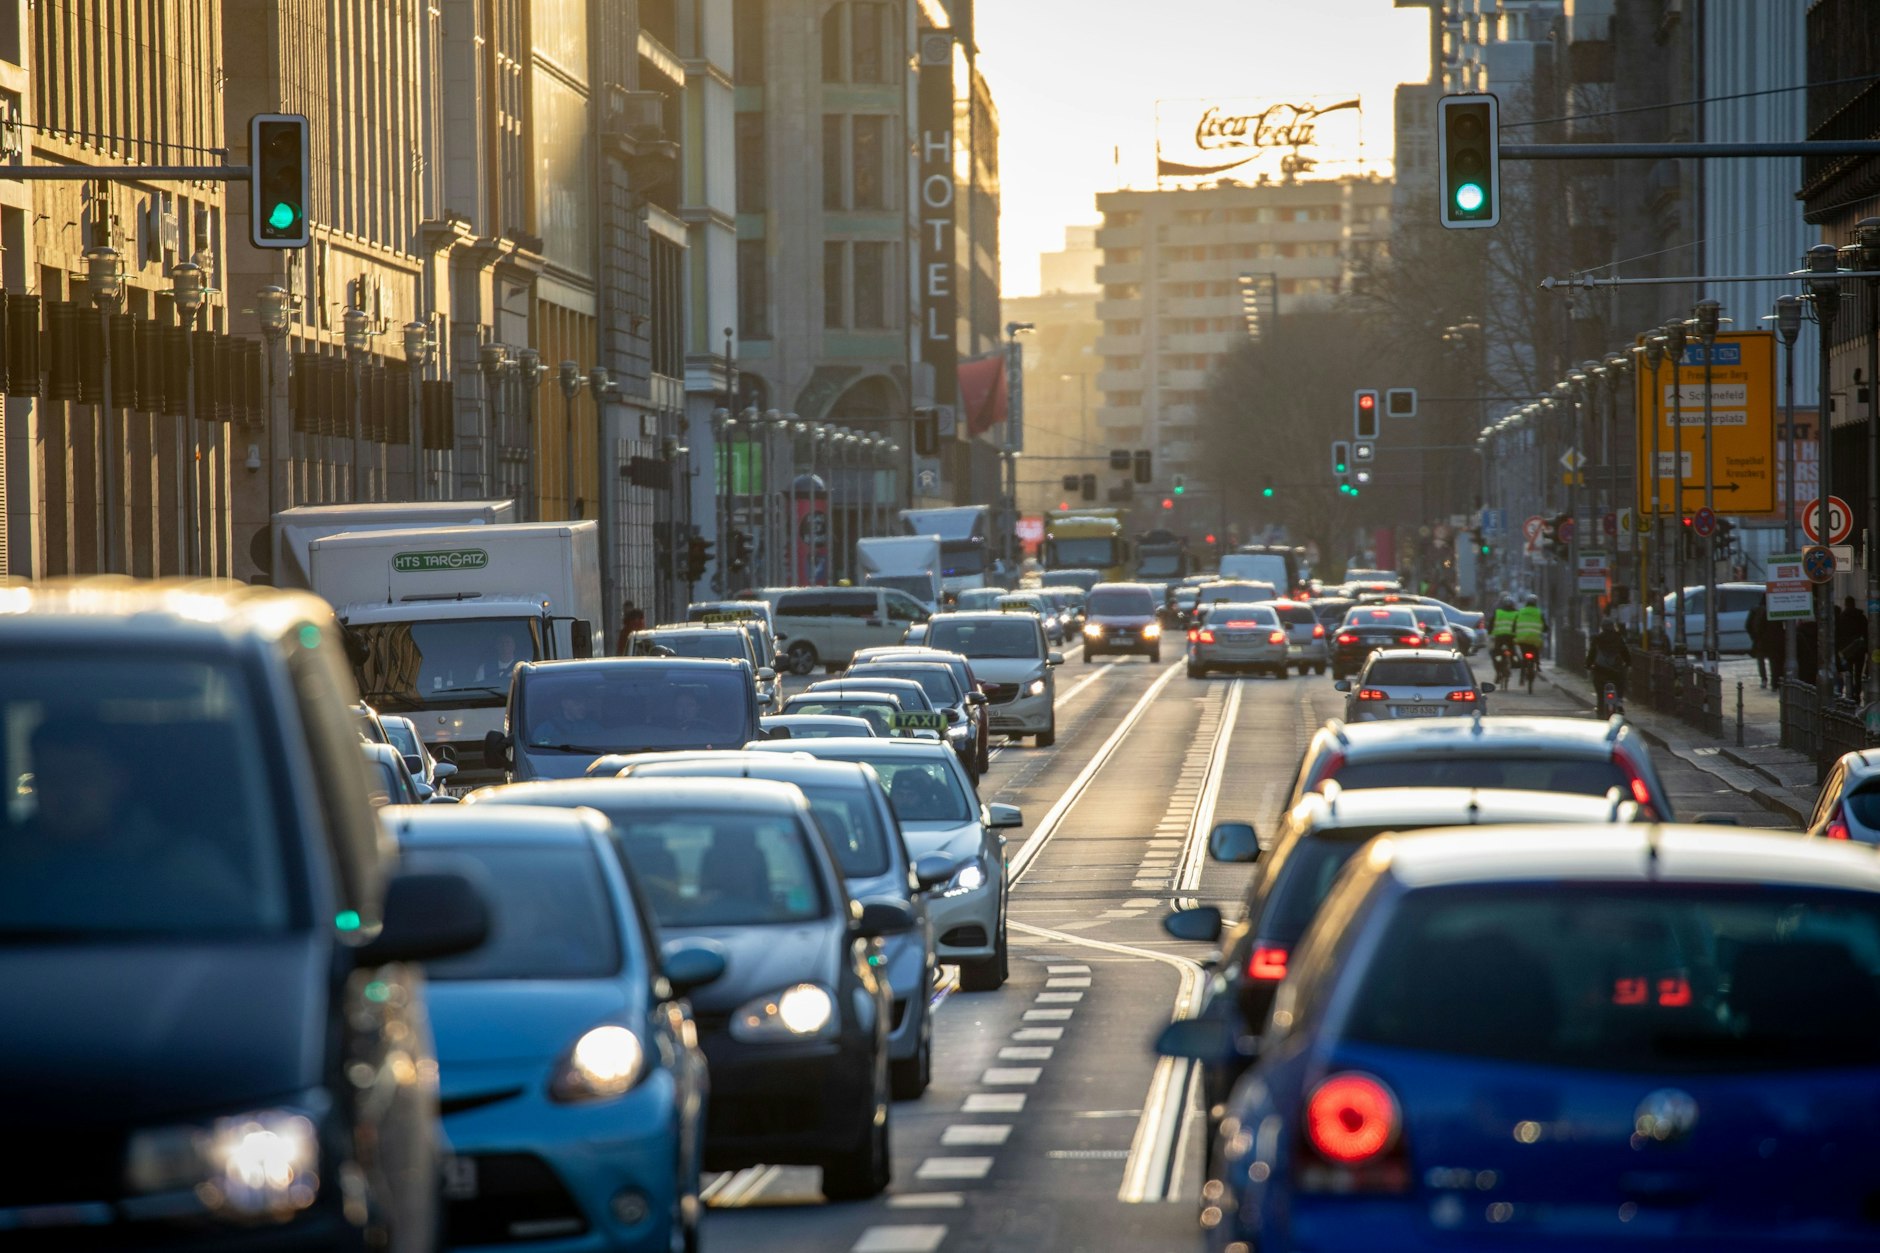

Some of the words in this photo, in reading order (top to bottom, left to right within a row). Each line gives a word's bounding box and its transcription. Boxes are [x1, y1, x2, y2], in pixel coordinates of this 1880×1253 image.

[1196, 103, 1318, 149] Coca-Cola
[923, 130, 953, 340] HOTEL
[1687, 370, 1730, 379] Prenauer
[1731, 370, 1748, 381] Berg
[1688, 390, 1745, 401] Schnefeld
[1669, 414, 1745, 425] Aexanerplatz
[1725, 456, 1765, 466] Tempelhof
[395, 557, 420, 568] HTS
[423, 552, 485, 567] TARGATZ
[900, 714, 937, 727] TAXI
